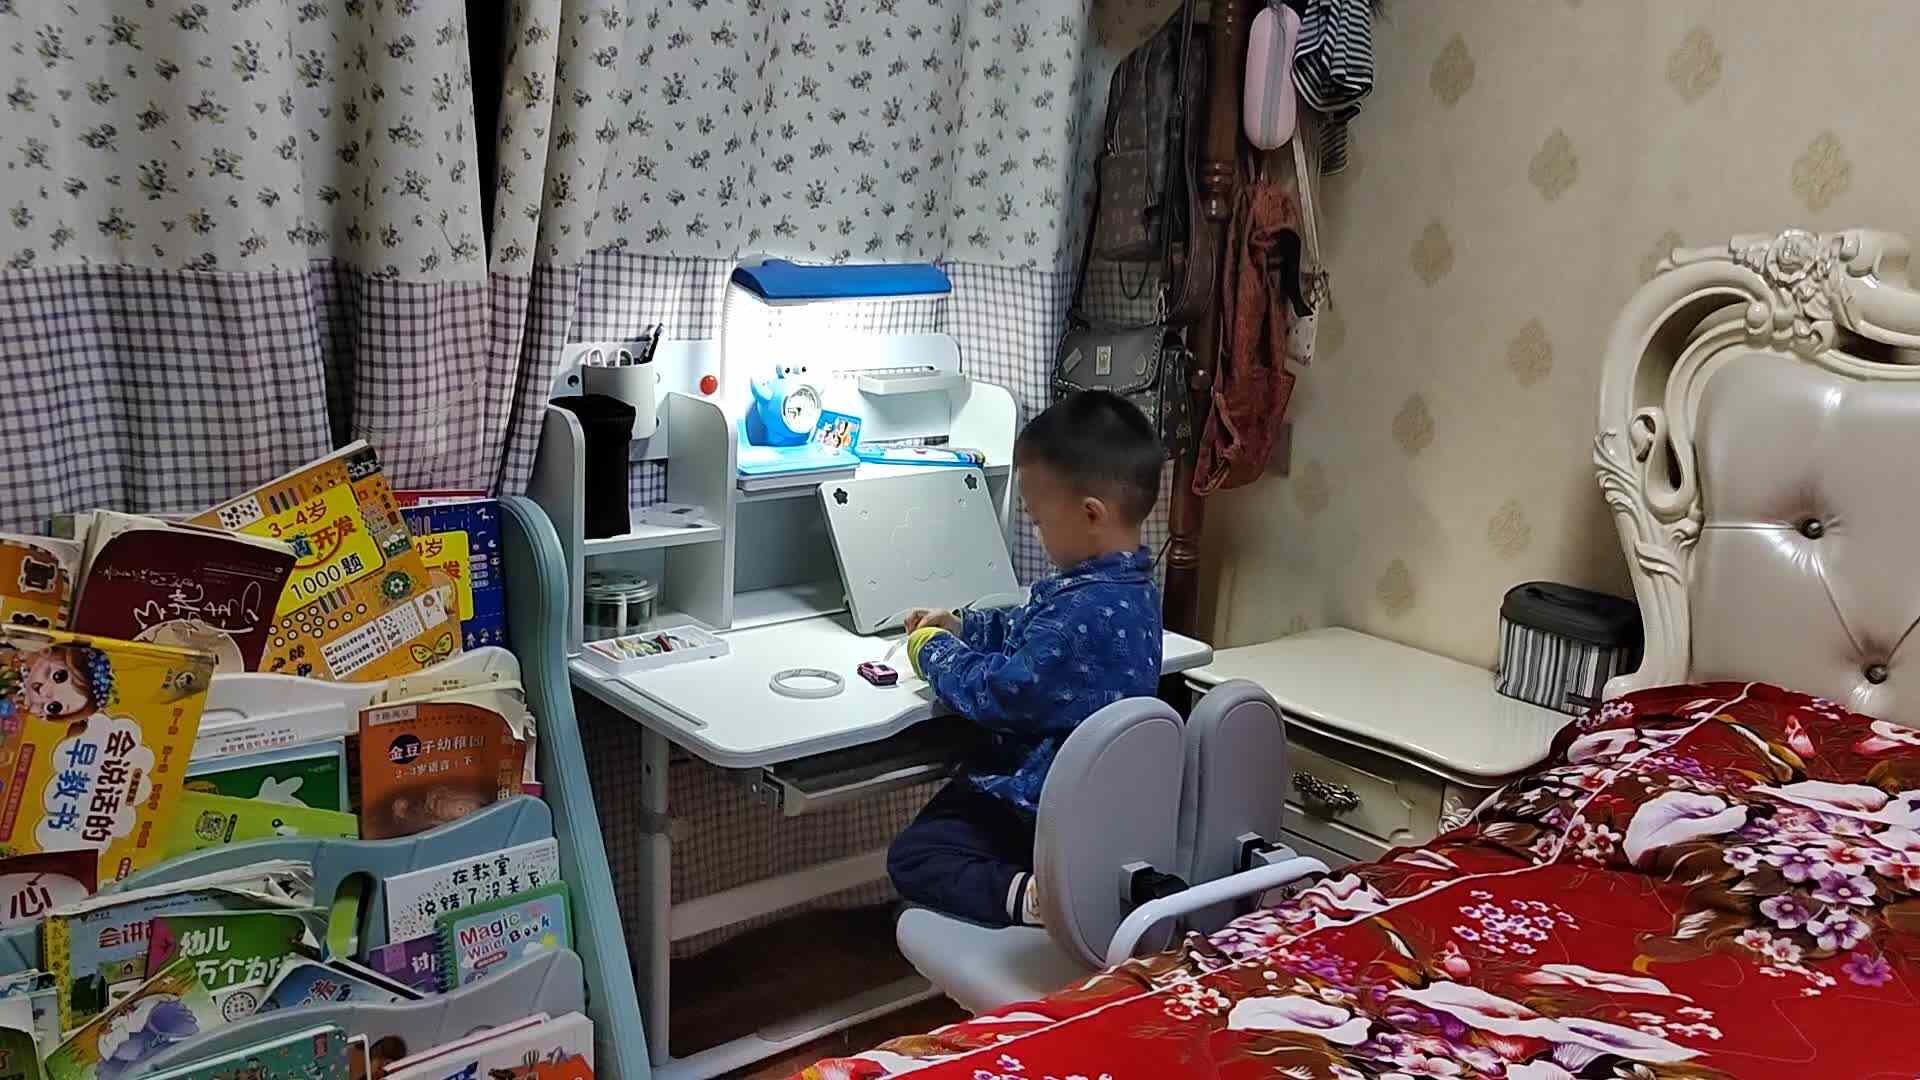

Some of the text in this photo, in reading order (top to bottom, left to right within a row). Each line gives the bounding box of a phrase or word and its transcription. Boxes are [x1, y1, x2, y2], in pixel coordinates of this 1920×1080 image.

[291, 552, 364, 601] 1000题
[48, 738, 98, 832] 早教书
[82, 730, 136, 842] 会说话的
[452, 855, 510, 886] 在教室
[179, 925, 231, 958] 幼儿
[459, 911, 522, 946] Magic
[467, 915, 551, 960] Water Book
